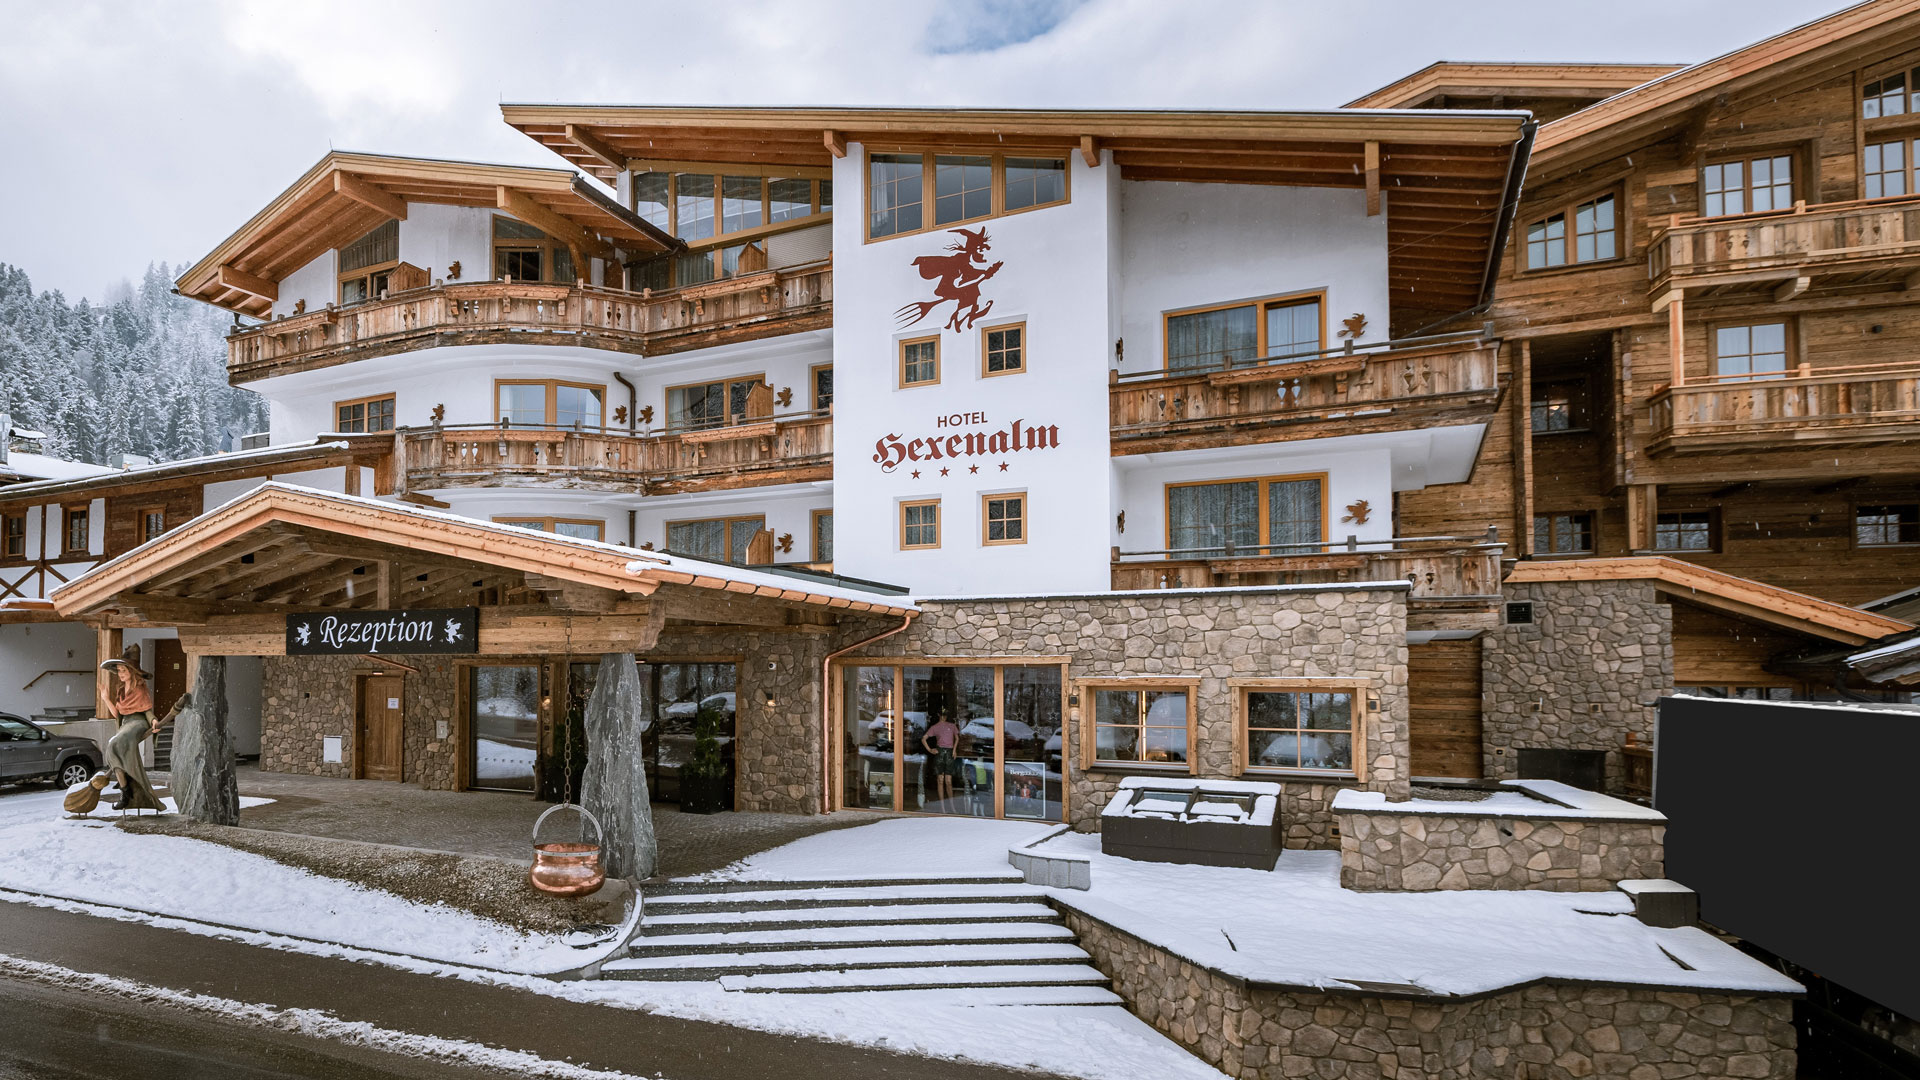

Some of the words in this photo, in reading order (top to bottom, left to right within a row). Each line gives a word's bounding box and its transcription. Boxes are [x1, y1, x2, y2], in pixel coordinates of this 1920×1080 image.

[938, 411, 988, 428] HOTEL
[872, 418, 1061, 474] Hexenalm
[319, 612, 434, 653] Rezeption
